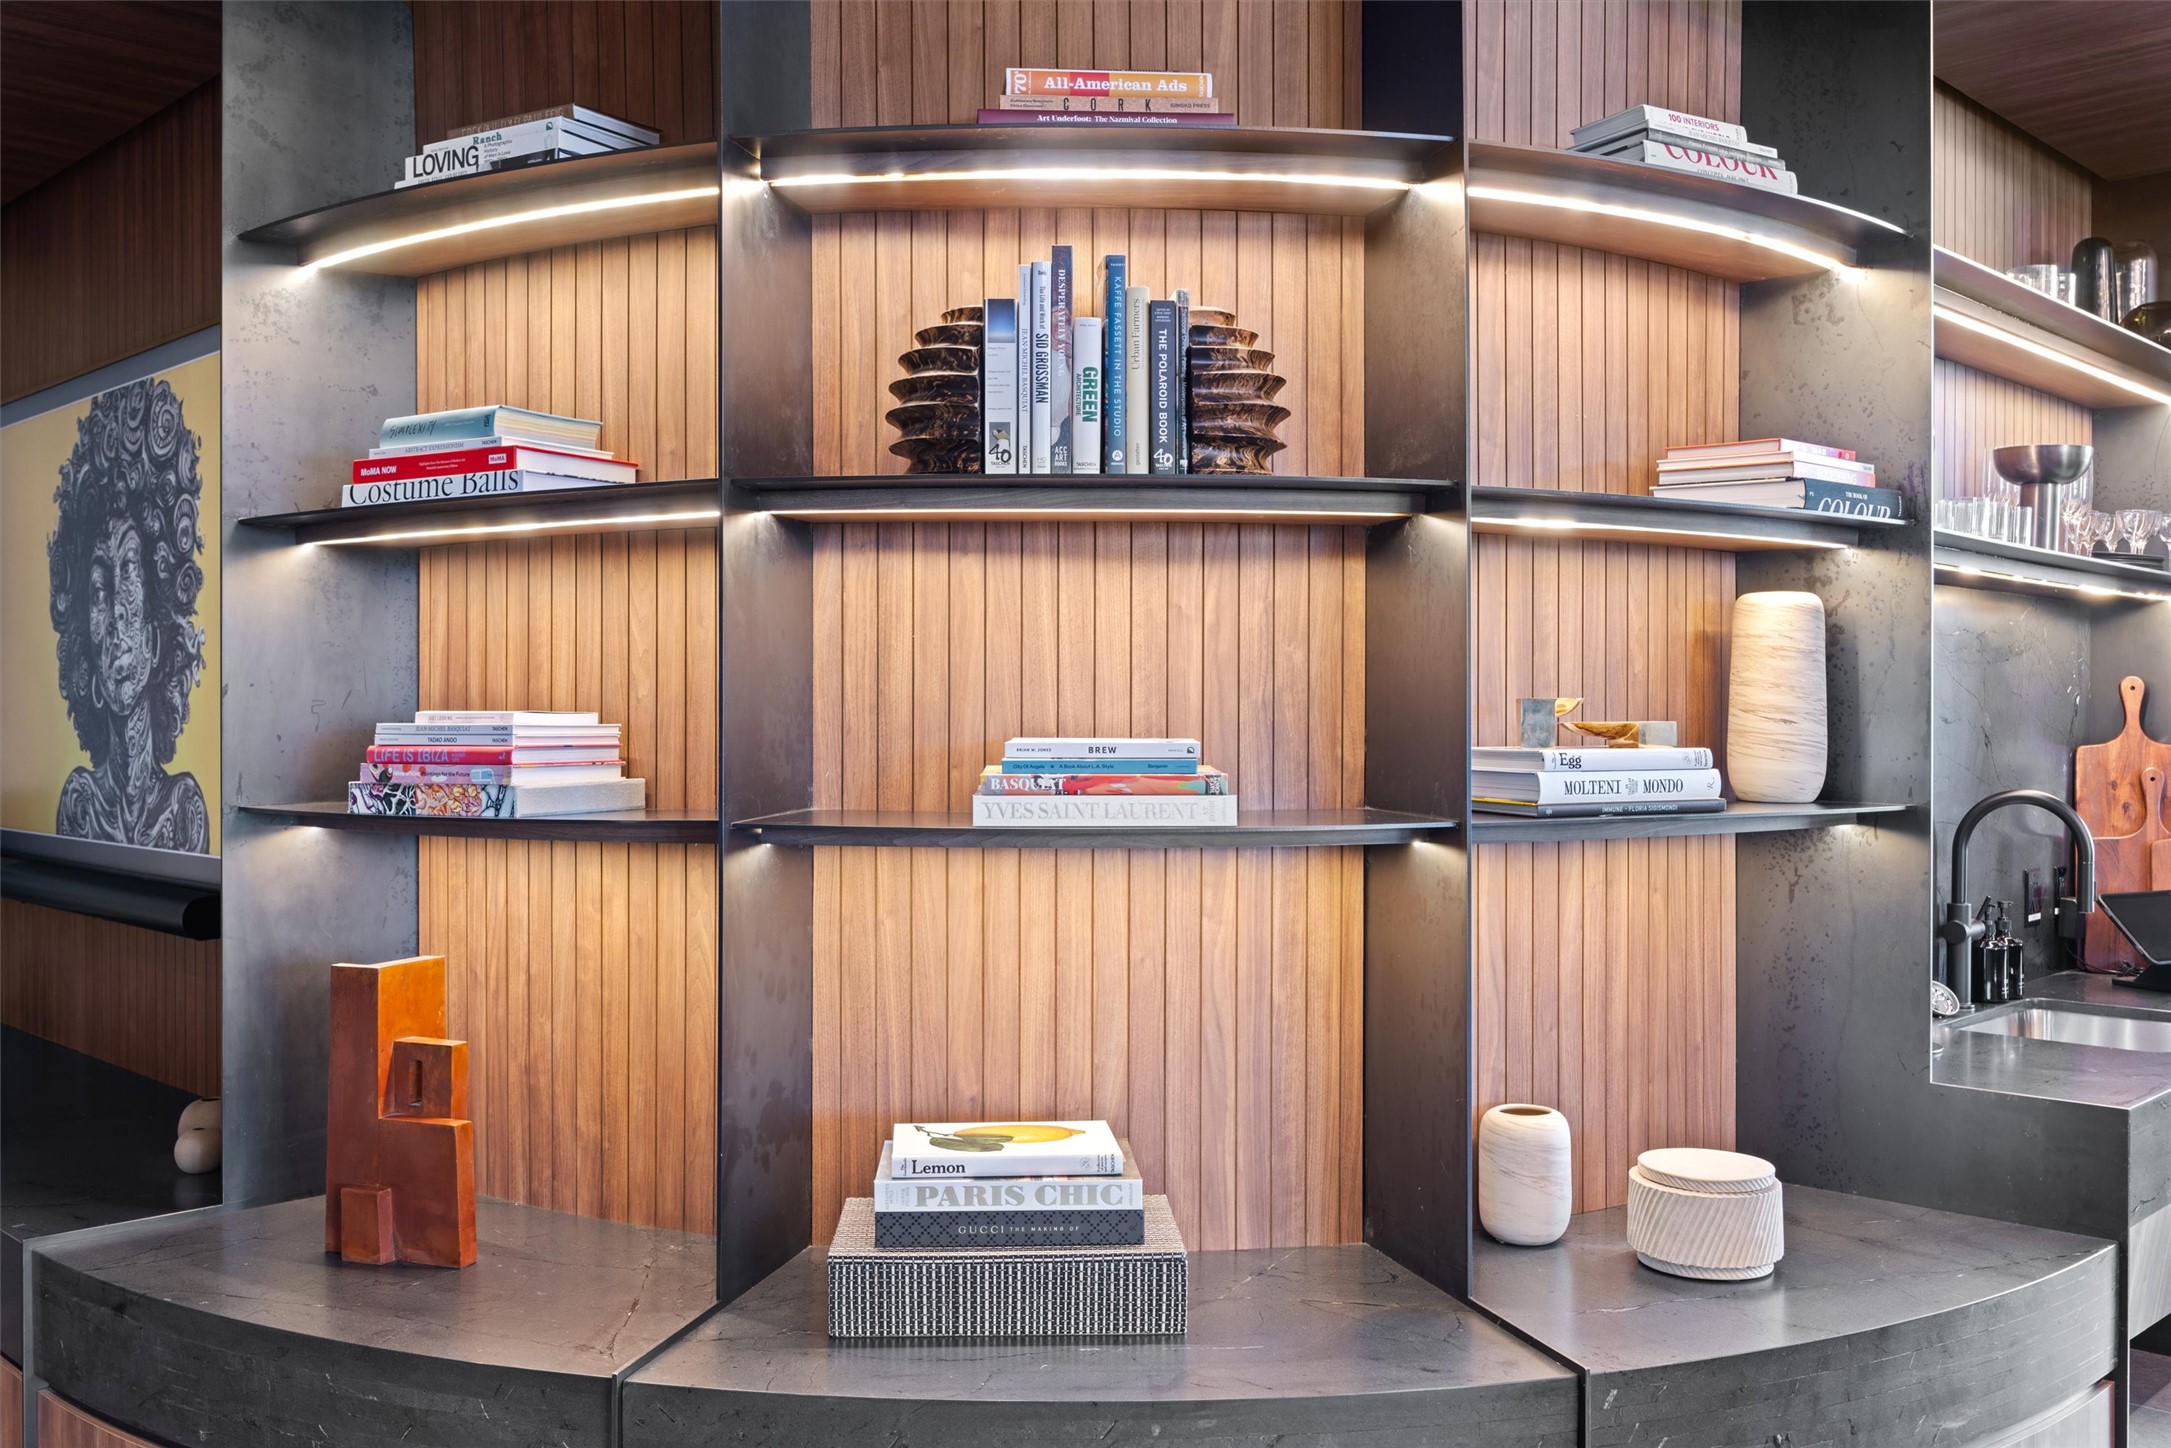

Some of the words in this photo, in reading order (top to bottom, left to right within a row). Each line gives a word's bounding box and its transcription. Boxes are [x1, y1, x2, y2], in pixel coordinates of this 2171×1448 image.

[1044, 76, 1153, 92] All-American
[1156, 79, 1188, 92] Ads
[1037, 114, 1050, 122] Art
[1051, 115, 1092, 123] Underfoot:
[1094, 115, 1108, 123] The
[1142, 116, 1178, 124] Collection
[1668, 113, 1682, 124] 100
[1683, 117, 1720, 131] INTERIORS
[473, 132, 502, 145] Ranch
[413, 145, 479, 178] LOVING
[1113, 276, 1122, 308] KAFFE
[1057, 269, 1067, 339] DESPERATELY
[1131, 298, 1140, 338] Farmers
[1035, 333, 1049, 349] SID
[1113, 313, 1122, 355] FASSETT
[1158, 328, 1167, 350] THE
[1131, 339, 1140, 370] Urban
[1113, 359, 1122, 370] IN
[1035, 351, 1049, 404] GROSSMAN
[1113, 375, 1122, 394] THE
[1158, 354, 1167, 409] POLAROID
[1082, 366, 1099, 423] GREEN
[1113, 398, 1122, 437] STUDIO
[1158, 412, 1167, 444] BOOK
[989, 444, 1012, 463] 40
[1055, 446, 1068, 454] ACC
[1055, 454, 1068, 462] ART
[1153, 448, 1173, 466] 40
[360, 466, 381, 476] MoMA
[381, 465, 397, 475] NOW
[349, 476, 454, 505] Costume
[462, 470, 519, 495] Balls
[374, 748, 400, 762] LIFE
[402, 748, 414, 762] IS
[417, 748, 449, 762] IBIZA
[1088, 746, 1117, 754] BREW
[1559, 752, 1582, 769] Egg
[1564, 779, 1621, 795] MOLTENI
[1643, 778, 1684, 794] MONDO
[982, 802, 1034, 820] YVES
[1037, 802, 1099, 820] SAINT
[1101, 801, 1200, 820] LAURENT
[1602, 805, 1623, 813] IMMUNE
[911, 1159, 966, 1174] Lemon
[914, 1185, 1024, 1207] PARIS
[1034, 1184, 1123, 1206] CHIC
[958, 1225, 1004, 1234] GUCCI
